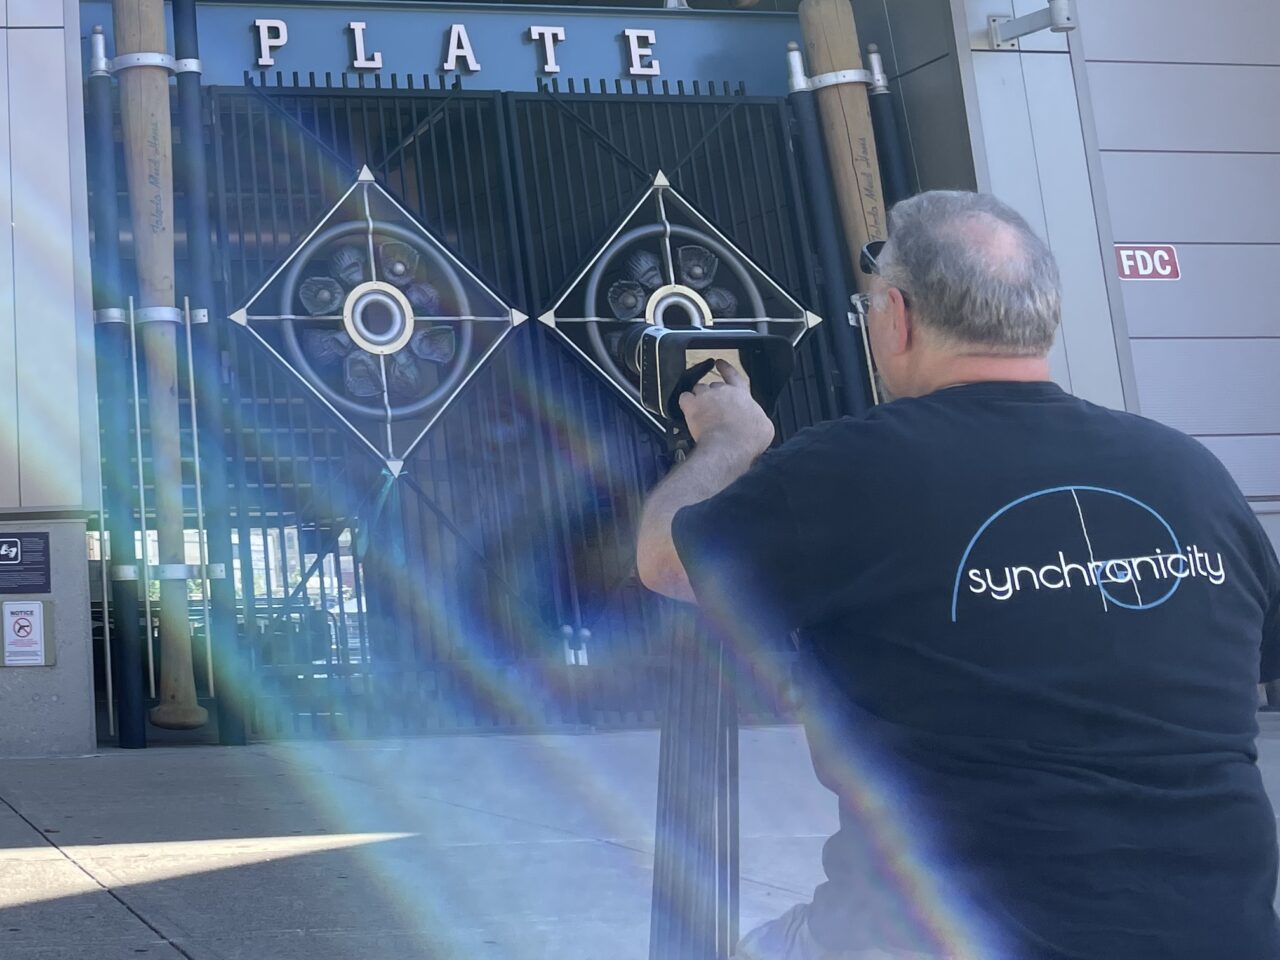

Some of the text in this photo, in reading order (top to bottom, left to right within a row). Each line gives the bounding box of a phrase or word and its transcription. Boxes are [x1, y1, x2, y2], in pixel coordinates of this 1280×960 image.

[254, 18, 661, 76] PLATE
[1120, 250, 1171, 275] FDC
[969, 544, 1225, 600] synchronicity
